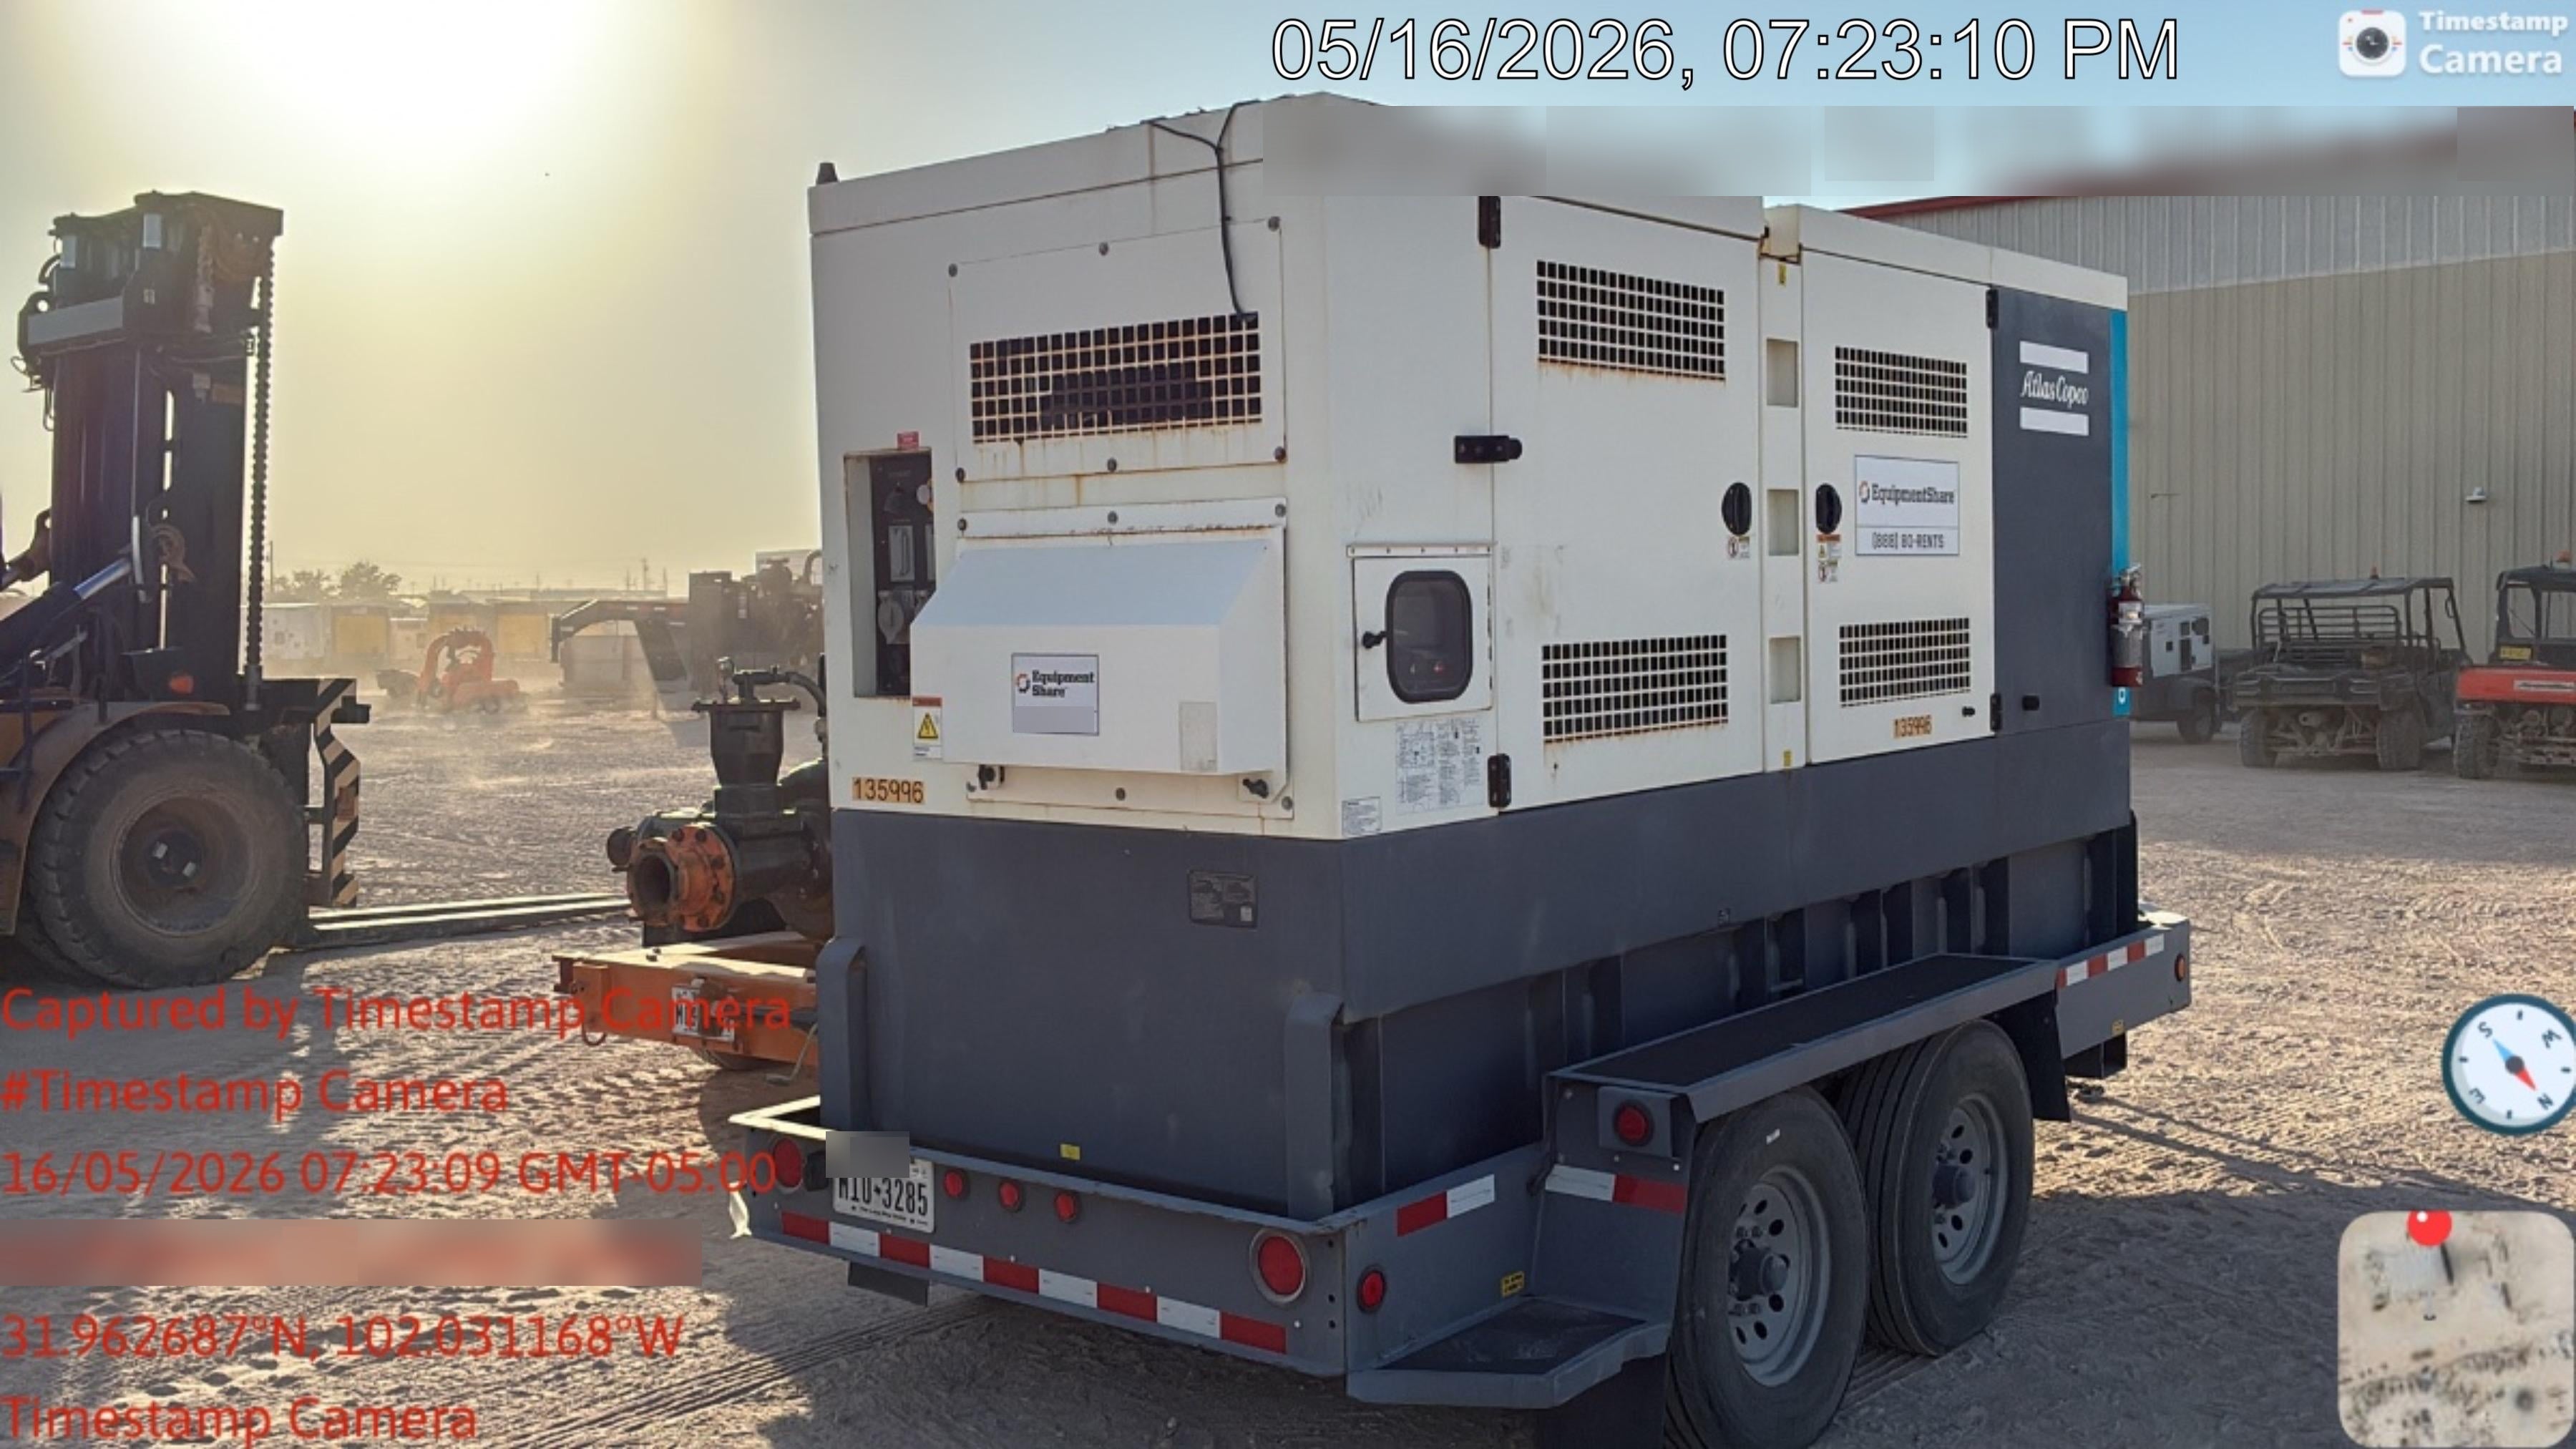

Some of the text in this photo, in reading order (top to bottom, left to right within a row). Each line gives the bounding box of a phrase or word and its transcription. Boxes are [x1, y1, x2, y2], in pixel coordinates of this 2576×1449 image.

[2021, 370, 2089, 409] Atlas Copco
[1871, 483, 1954, 506] EquipmentShare
[1032, 669, 1095, 686] Equipment
[1032, 684, 1065, 698] Share
[854, 777, 924, 804] 135996
